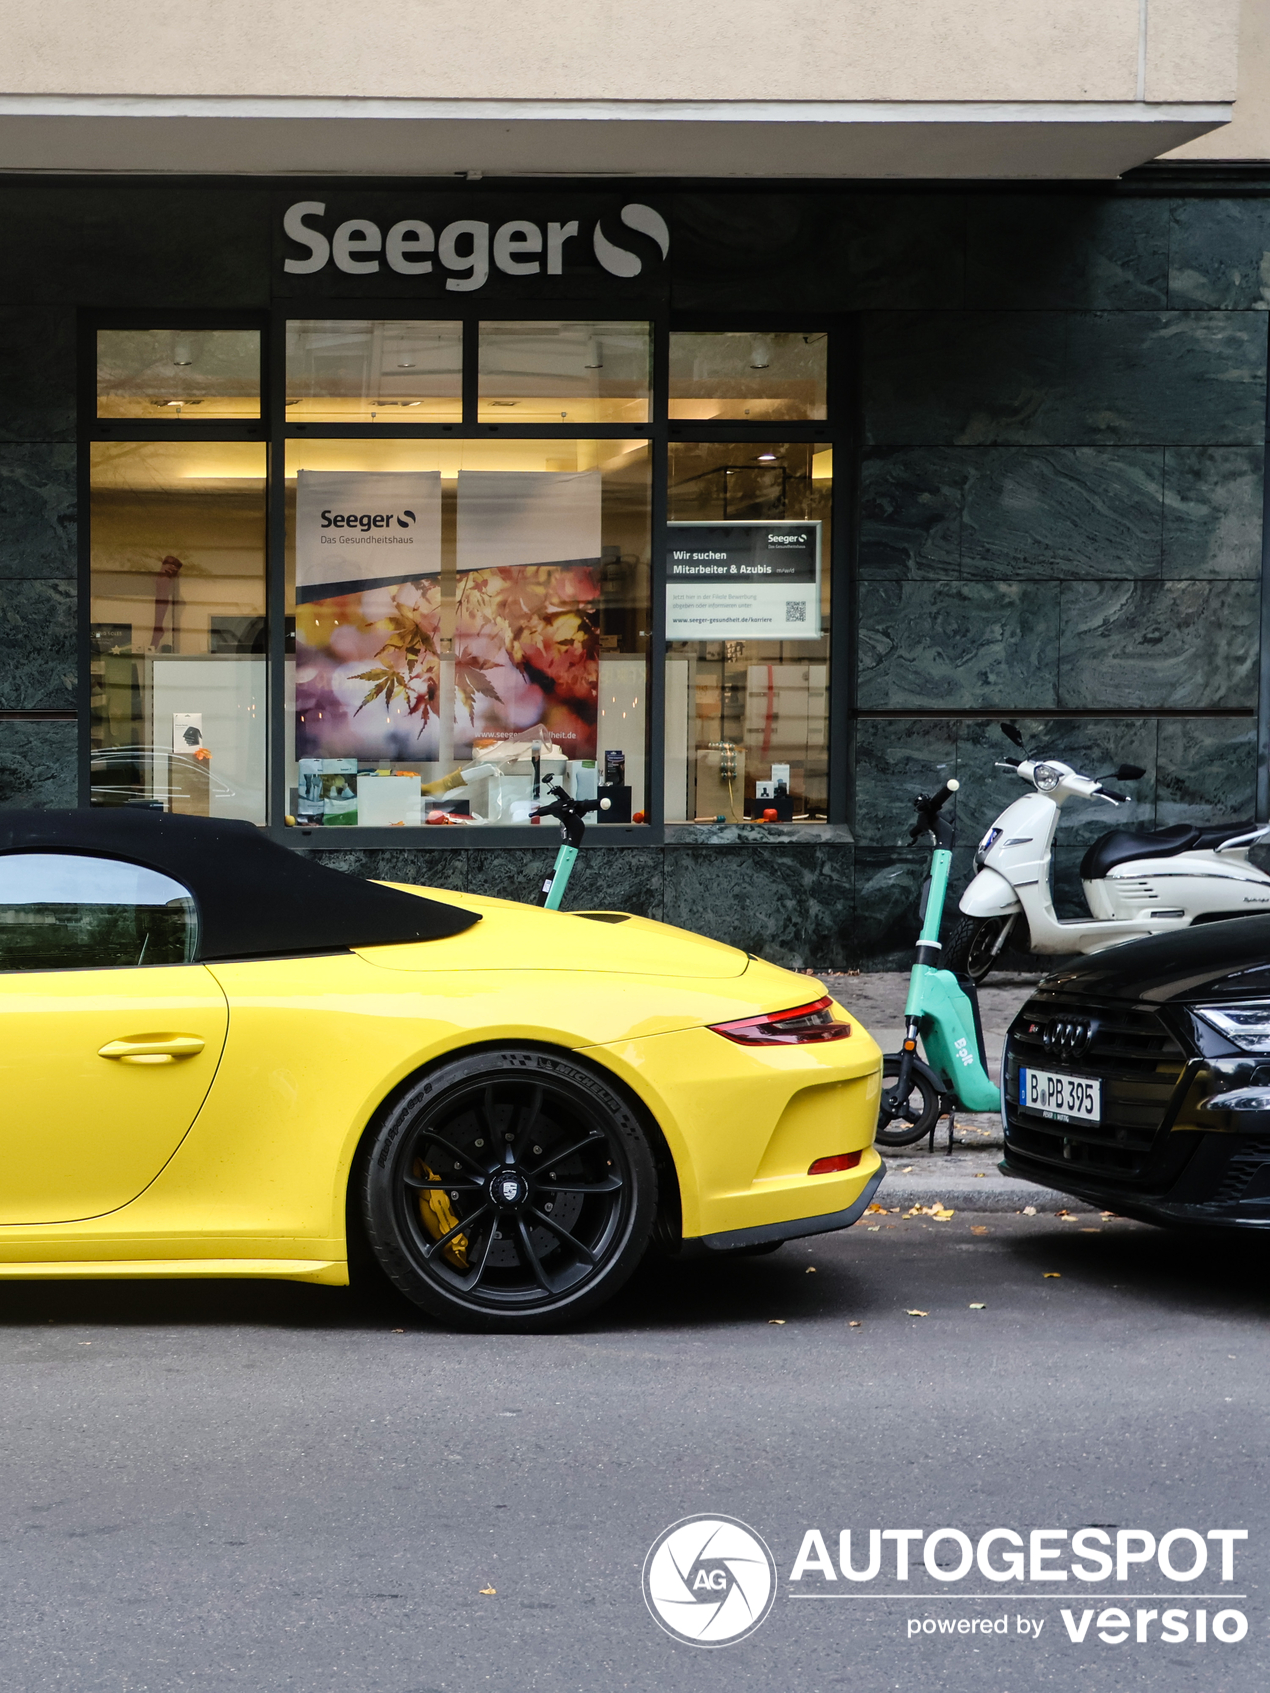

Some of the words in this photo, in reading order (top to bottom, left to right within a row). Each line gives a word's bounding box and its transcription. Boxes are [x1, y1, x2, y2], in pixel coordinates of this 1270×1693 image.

[283, 201, 578, 292] Seeger
[320, 509, 394, 532] Seeger
[320, 535, 337, 545] Das
[339, 535, 414, 545] Gesundheitshaus
[768, 533, 798, 544] Seeger
[673, 551, 691, 560] Wir
[692, 551, 727, 560] suchen
[673, 565, 728, 574] Mitarbeiter
[729, 565, 738, 574] &
[740, 565, 772, 574] Azubis
[954, 1037, 974, 1067] Bolt
[407, 1092, 425, 1111] Cup
[424, 1083, 433, 1094] 2
[556, 1064, 621, 1110] MICHELIN
[1030, 1074, 1040, 1104] B
[1047, 1077, 1064, 1109] PB
[1067, 1081, 1094, 1115] 395
